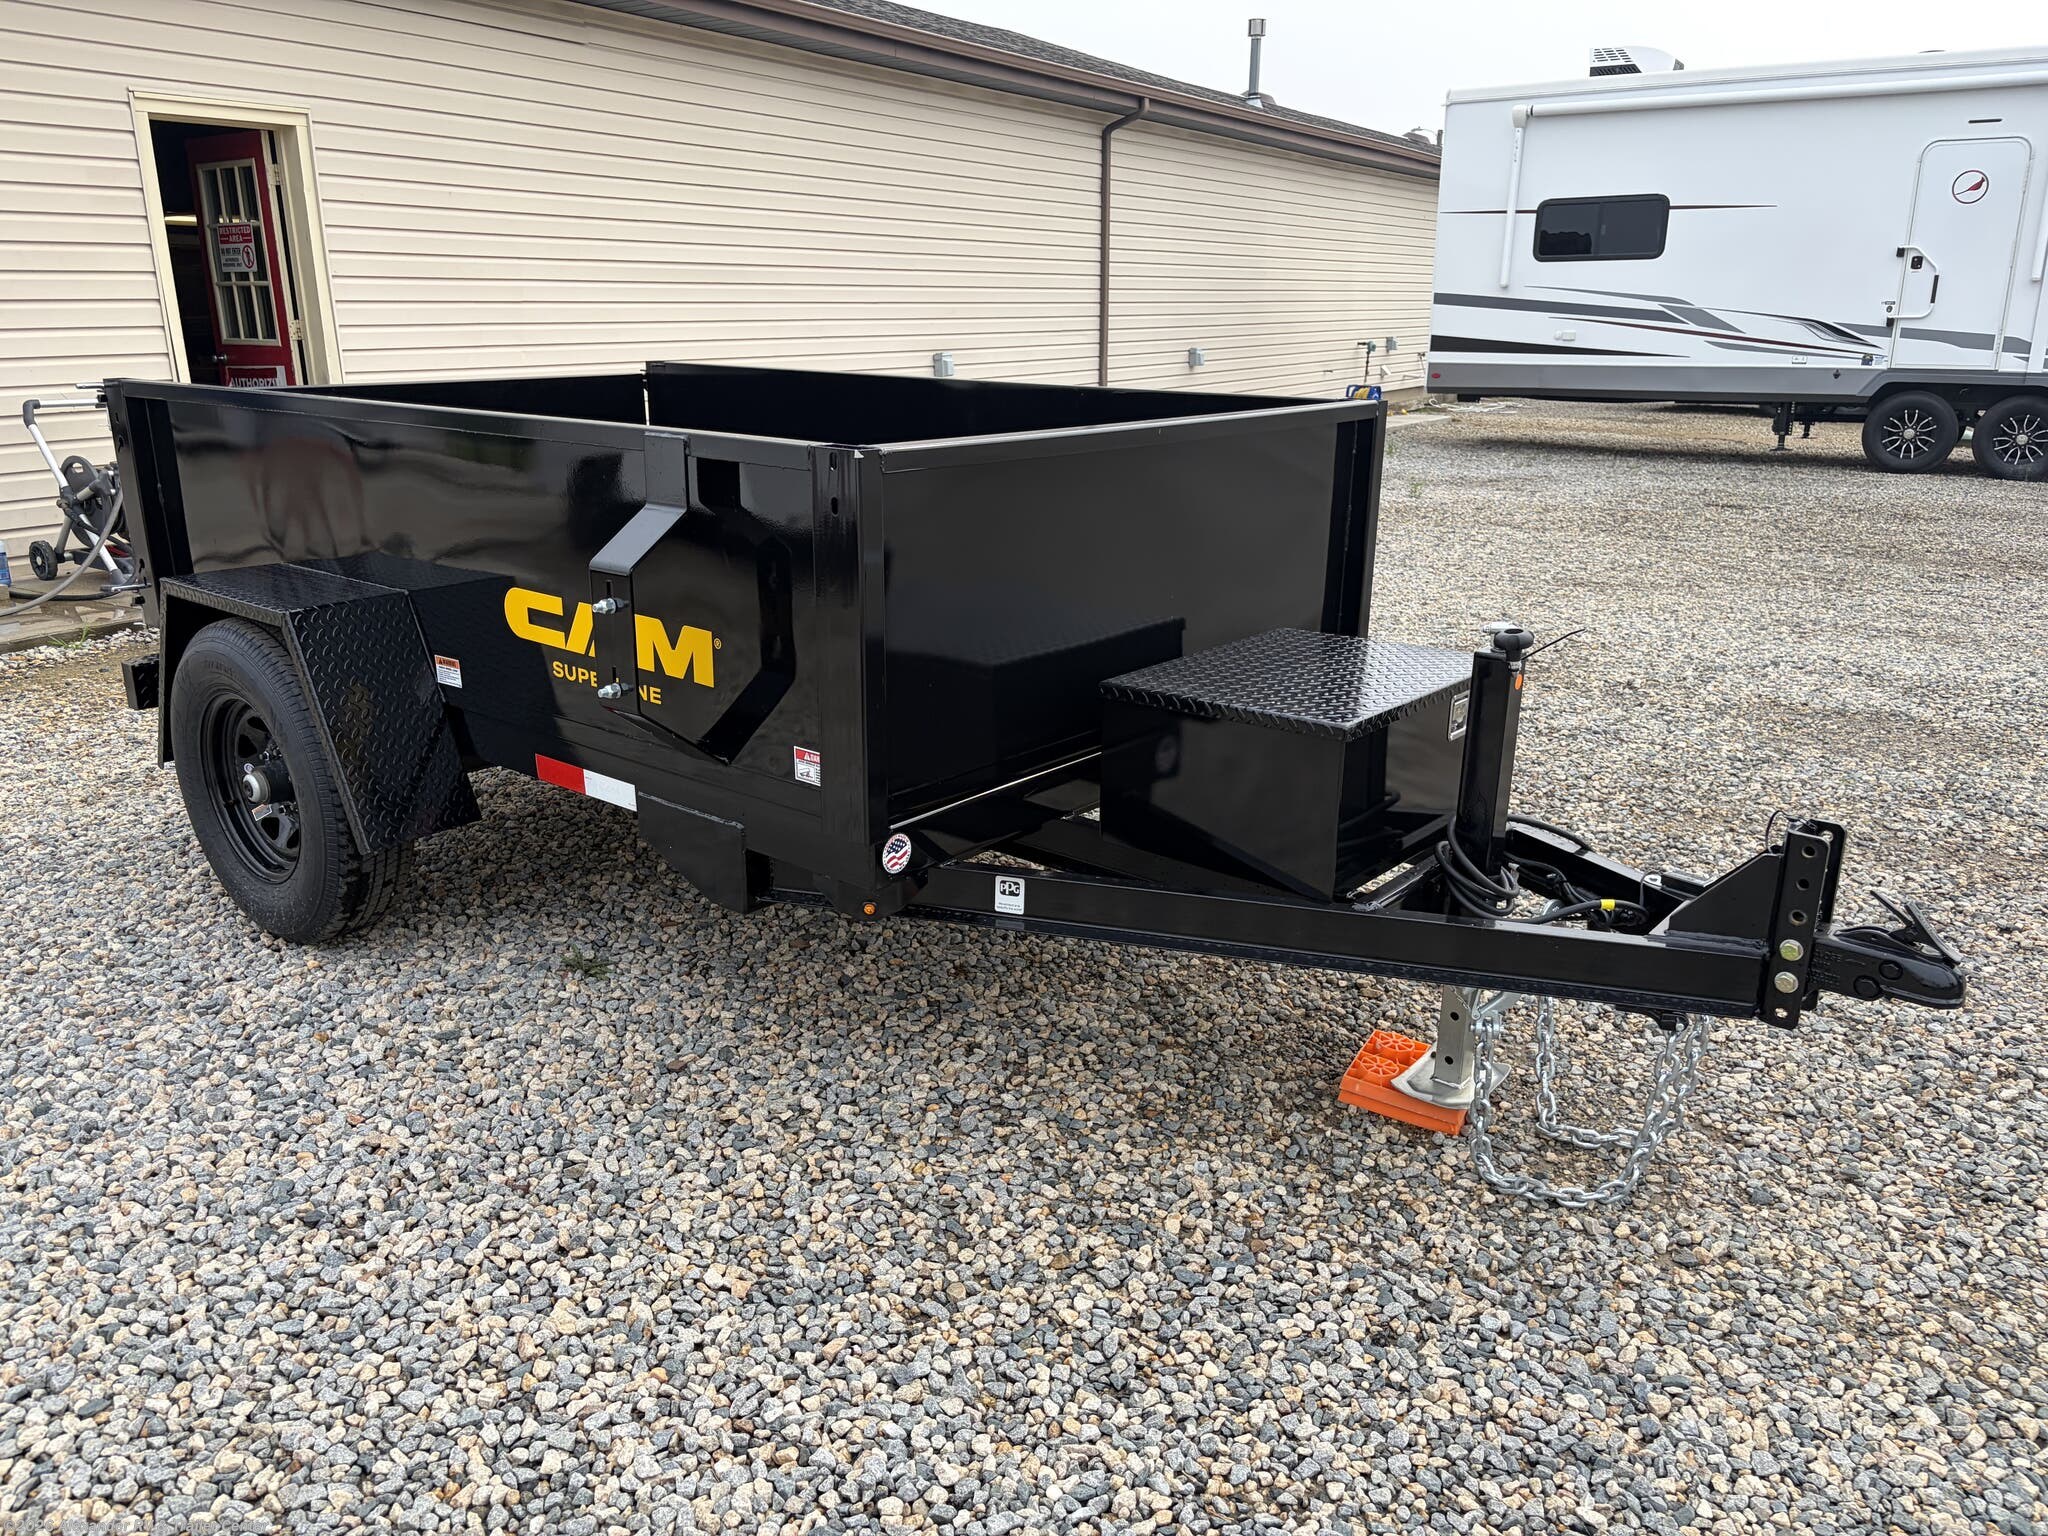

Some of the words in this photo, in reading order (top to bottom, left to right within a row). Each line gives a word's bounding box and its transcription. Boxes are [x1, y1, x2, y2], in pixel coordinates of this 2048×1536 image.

[219, 226, 251, 234] RESTRICTED
[229, 234, 243, 242] AREA
[552, 661, 662, 705] SUPENE
[1000, 881, 1020, 895] PPG
